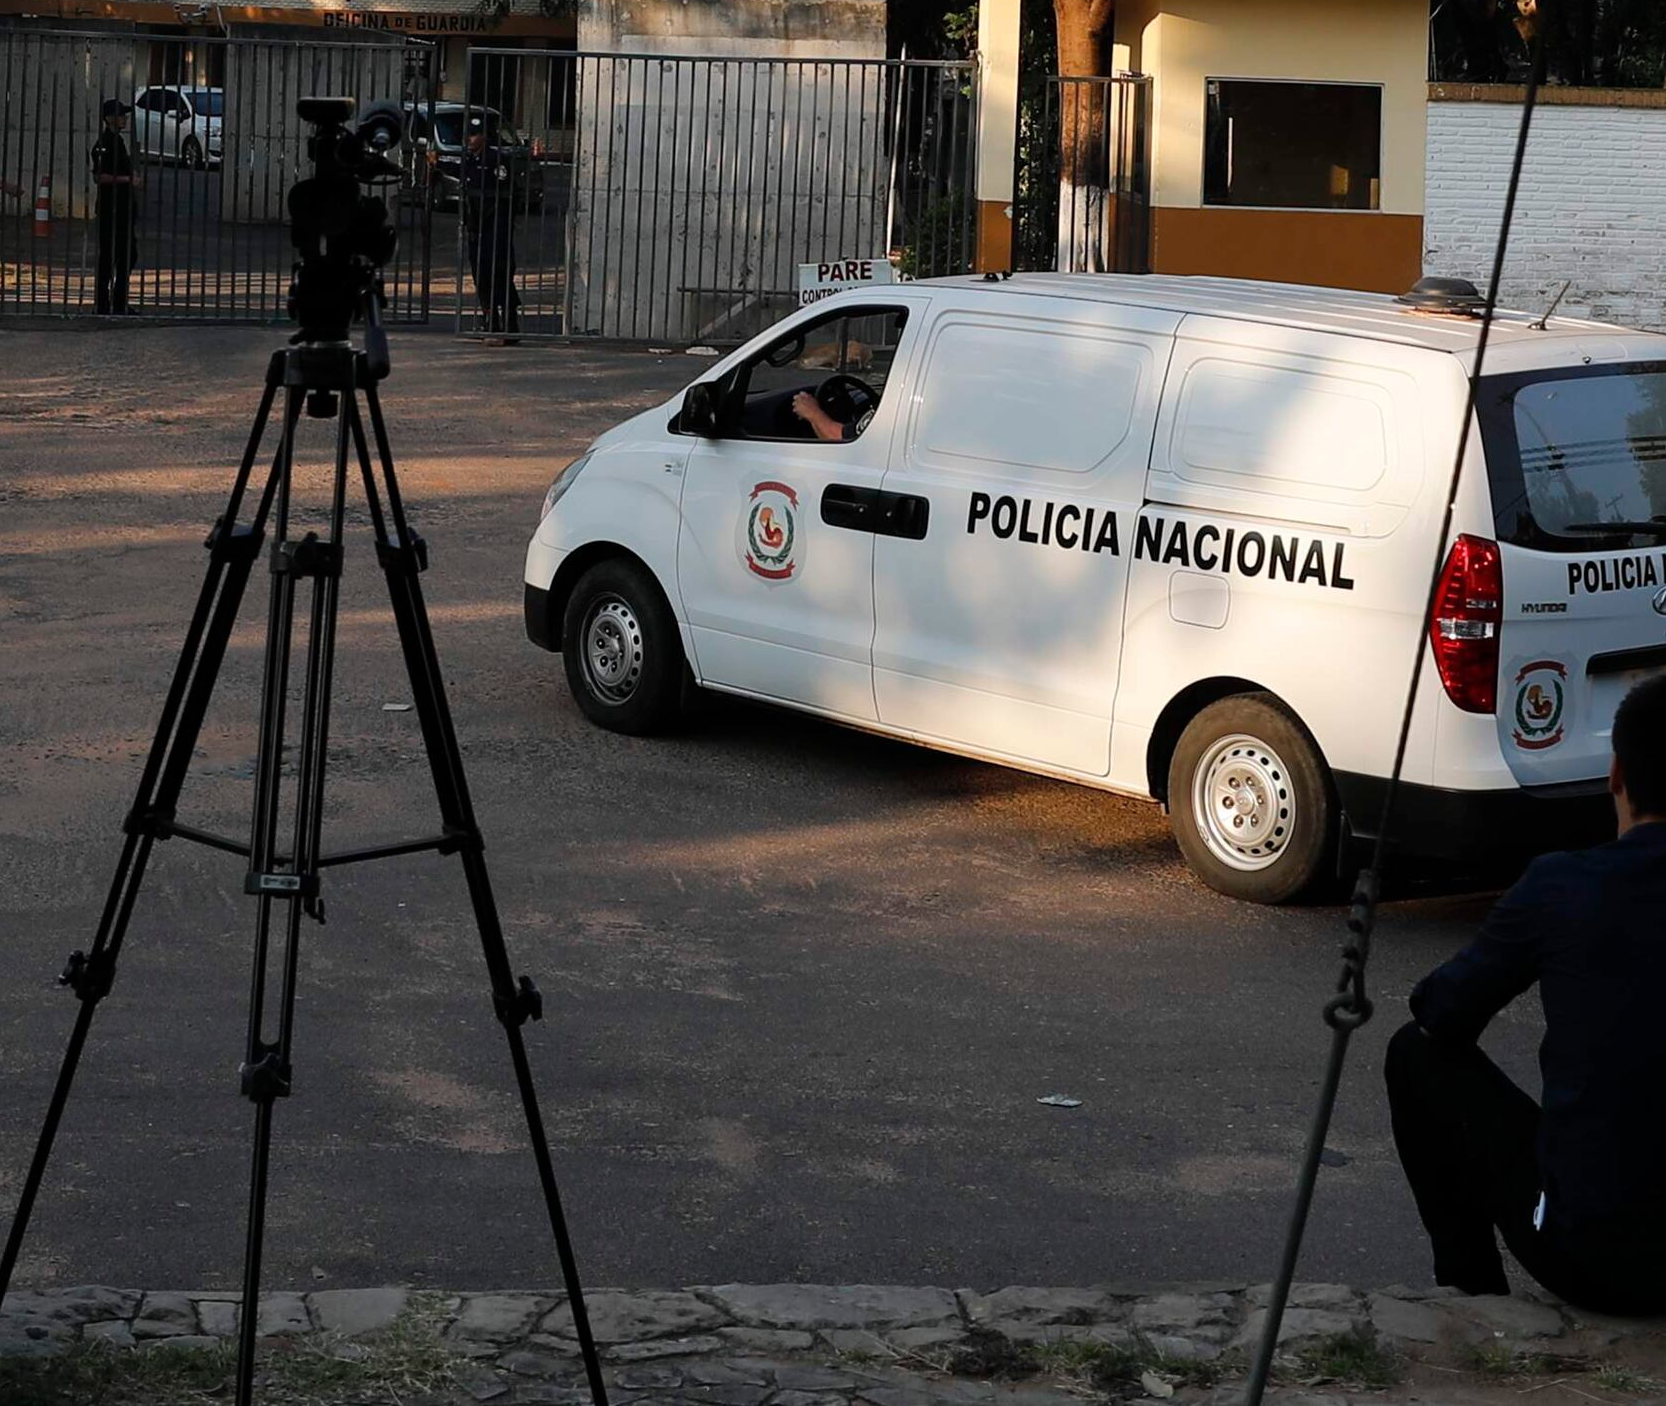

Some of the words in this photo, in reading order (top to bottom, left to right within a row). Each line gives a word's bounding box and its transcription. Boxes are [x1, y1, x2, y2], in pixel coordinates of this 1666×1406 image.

[324, 12, 389, 29] OFICINA
[395, 18, 411, 27] DE
[416, 16, 485, 31] GUARDIA
[818, 261, 872, 282] PARE
[967, 491, 1119, 556] POLICIA
[1135, 515, 1355, 590] NACIONAL
[1568, 556, 1657, 595] POLICIA
[1521, 603, 1567, 613] HYUNDAI
